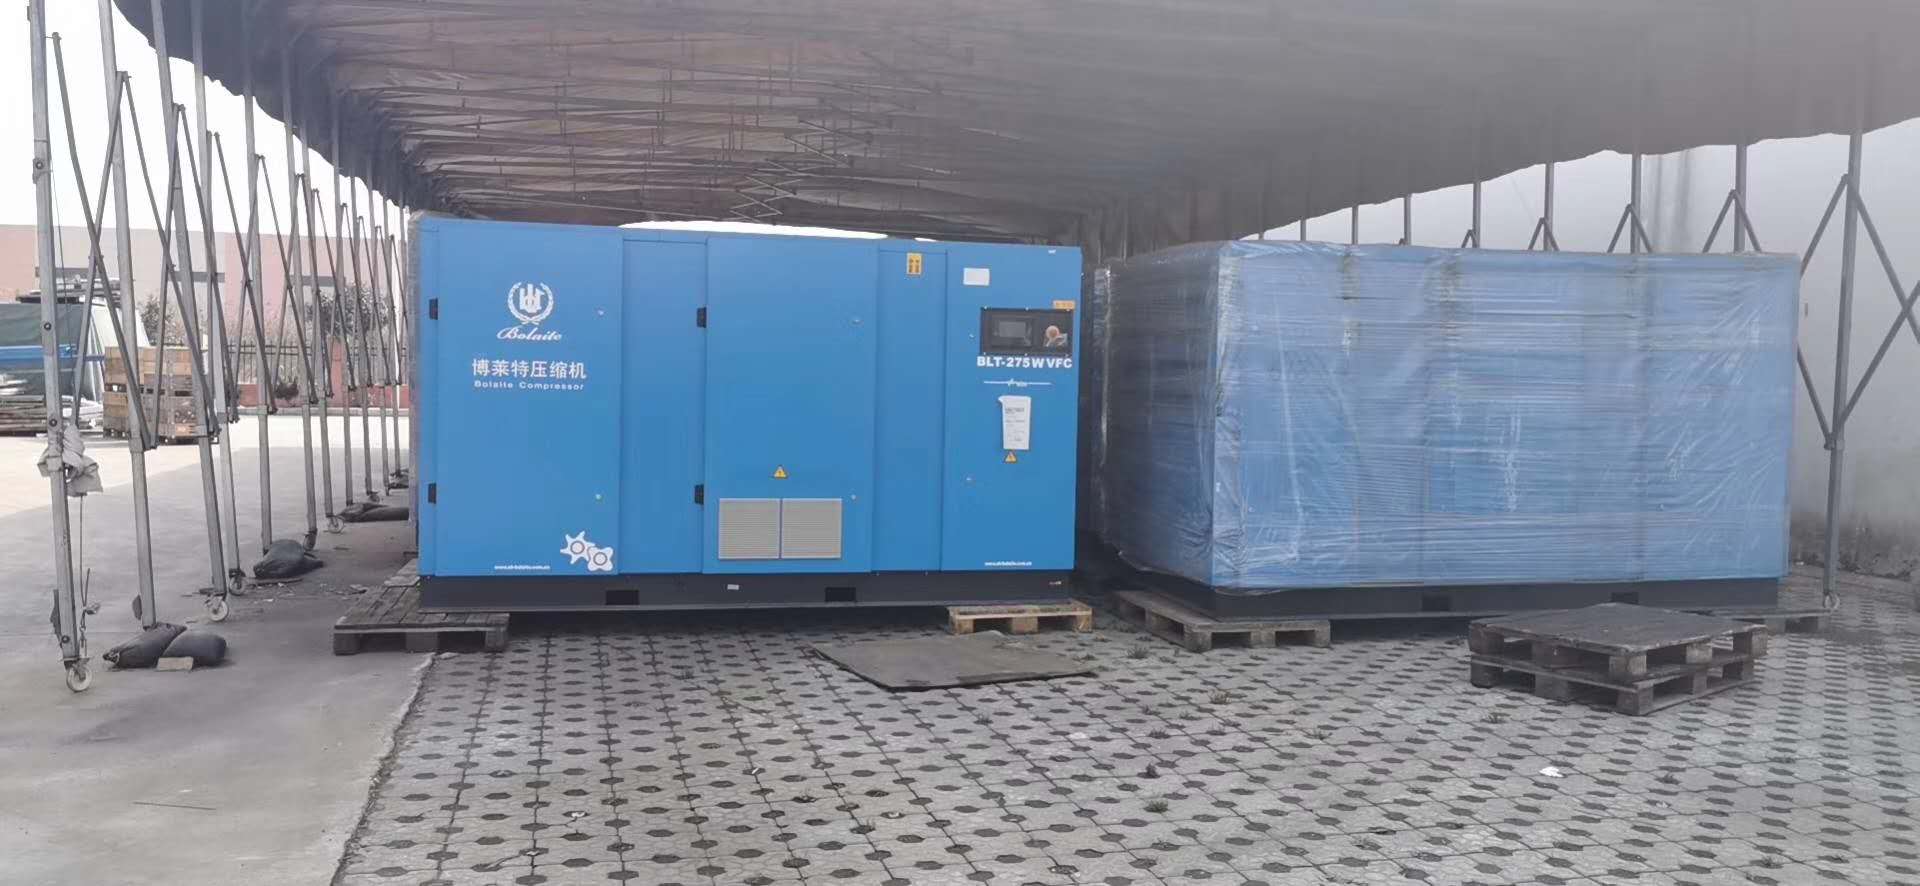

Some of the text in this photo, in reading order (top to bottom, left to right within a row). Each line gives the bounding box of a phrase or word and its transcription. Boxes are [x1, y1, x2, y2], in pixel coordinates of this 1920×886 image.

[496, 325, 562, 341] Bolaite
[472, 359, 587, 379] 博莱特压缩机
[474, 380, 584, 391] Bolaite Compressor
